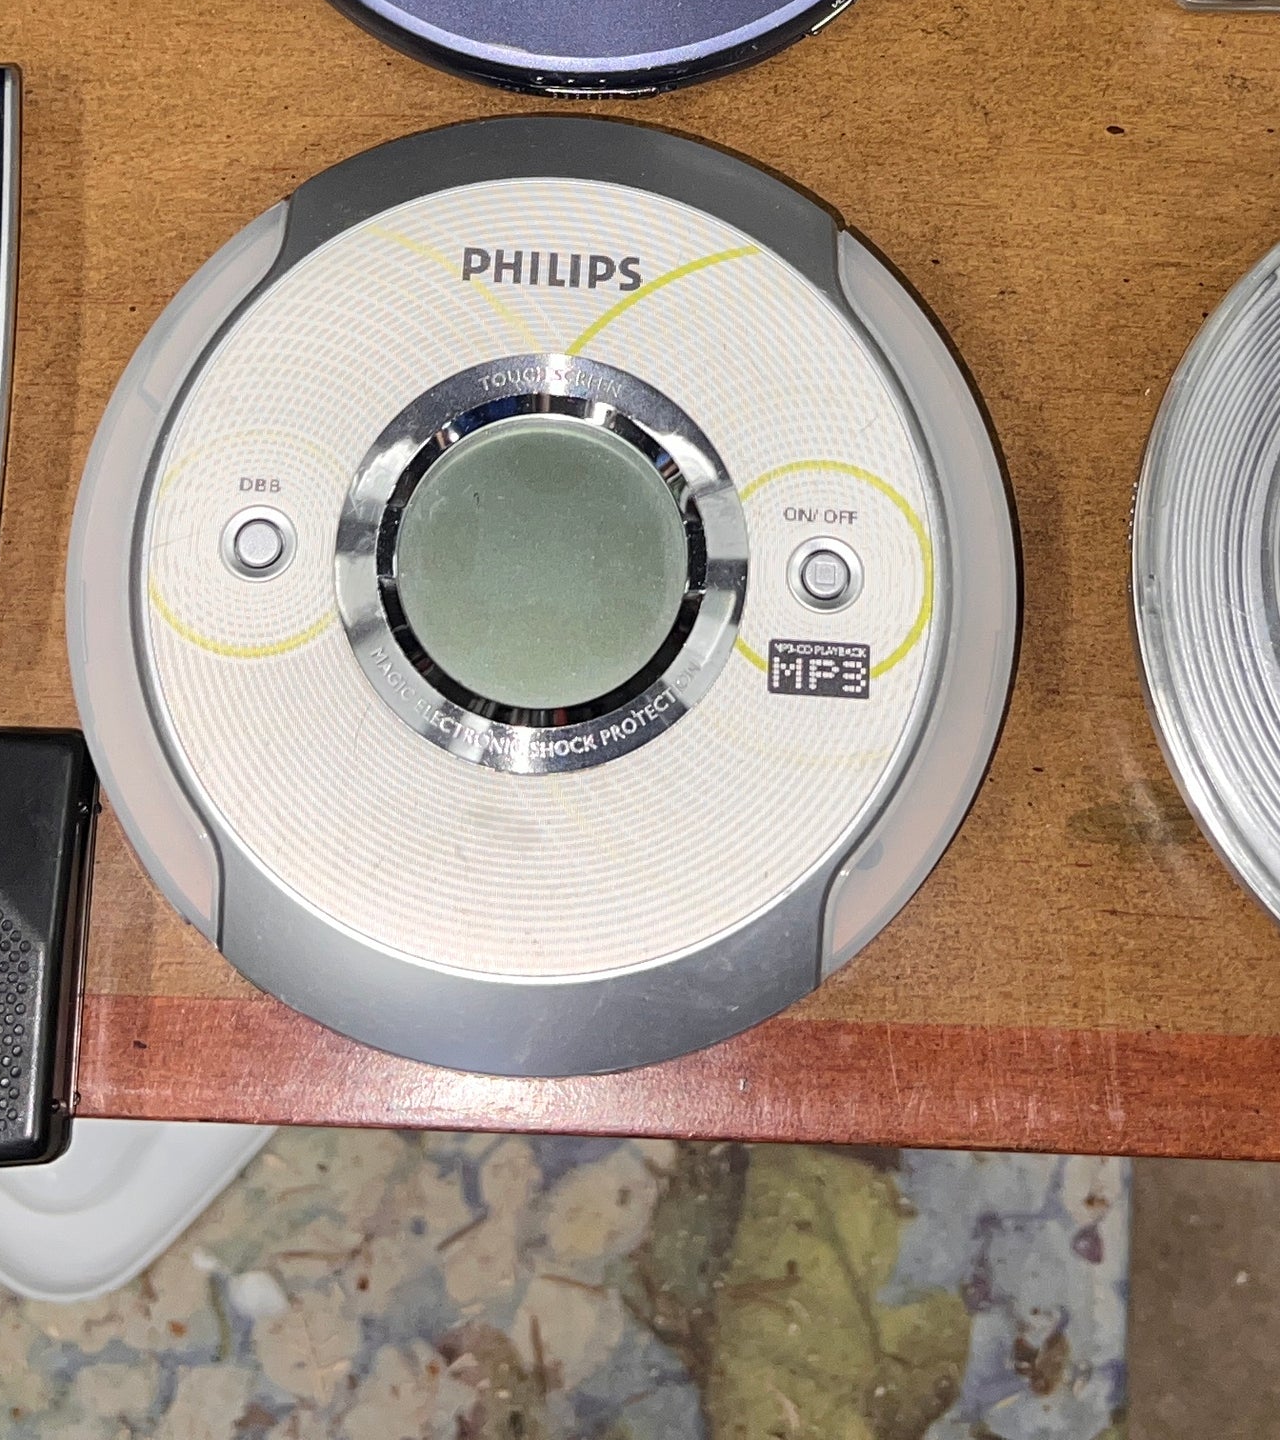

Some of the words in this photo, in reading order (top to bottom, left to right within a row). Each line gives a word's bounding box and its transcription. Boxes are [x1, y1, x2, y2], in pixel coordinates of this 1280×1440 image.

[462, 247, 643, 292] PHILIPS
[478, 366, 547, 392] TOUCH
[239, 476, 282, 493] DBB
[772, 656, 867, 693] MP3
[370, 647, 418, 701] MAGIC
[530, 733, 597, 759] SHOCK
[600, 662, 704, 747] PROTECTION
